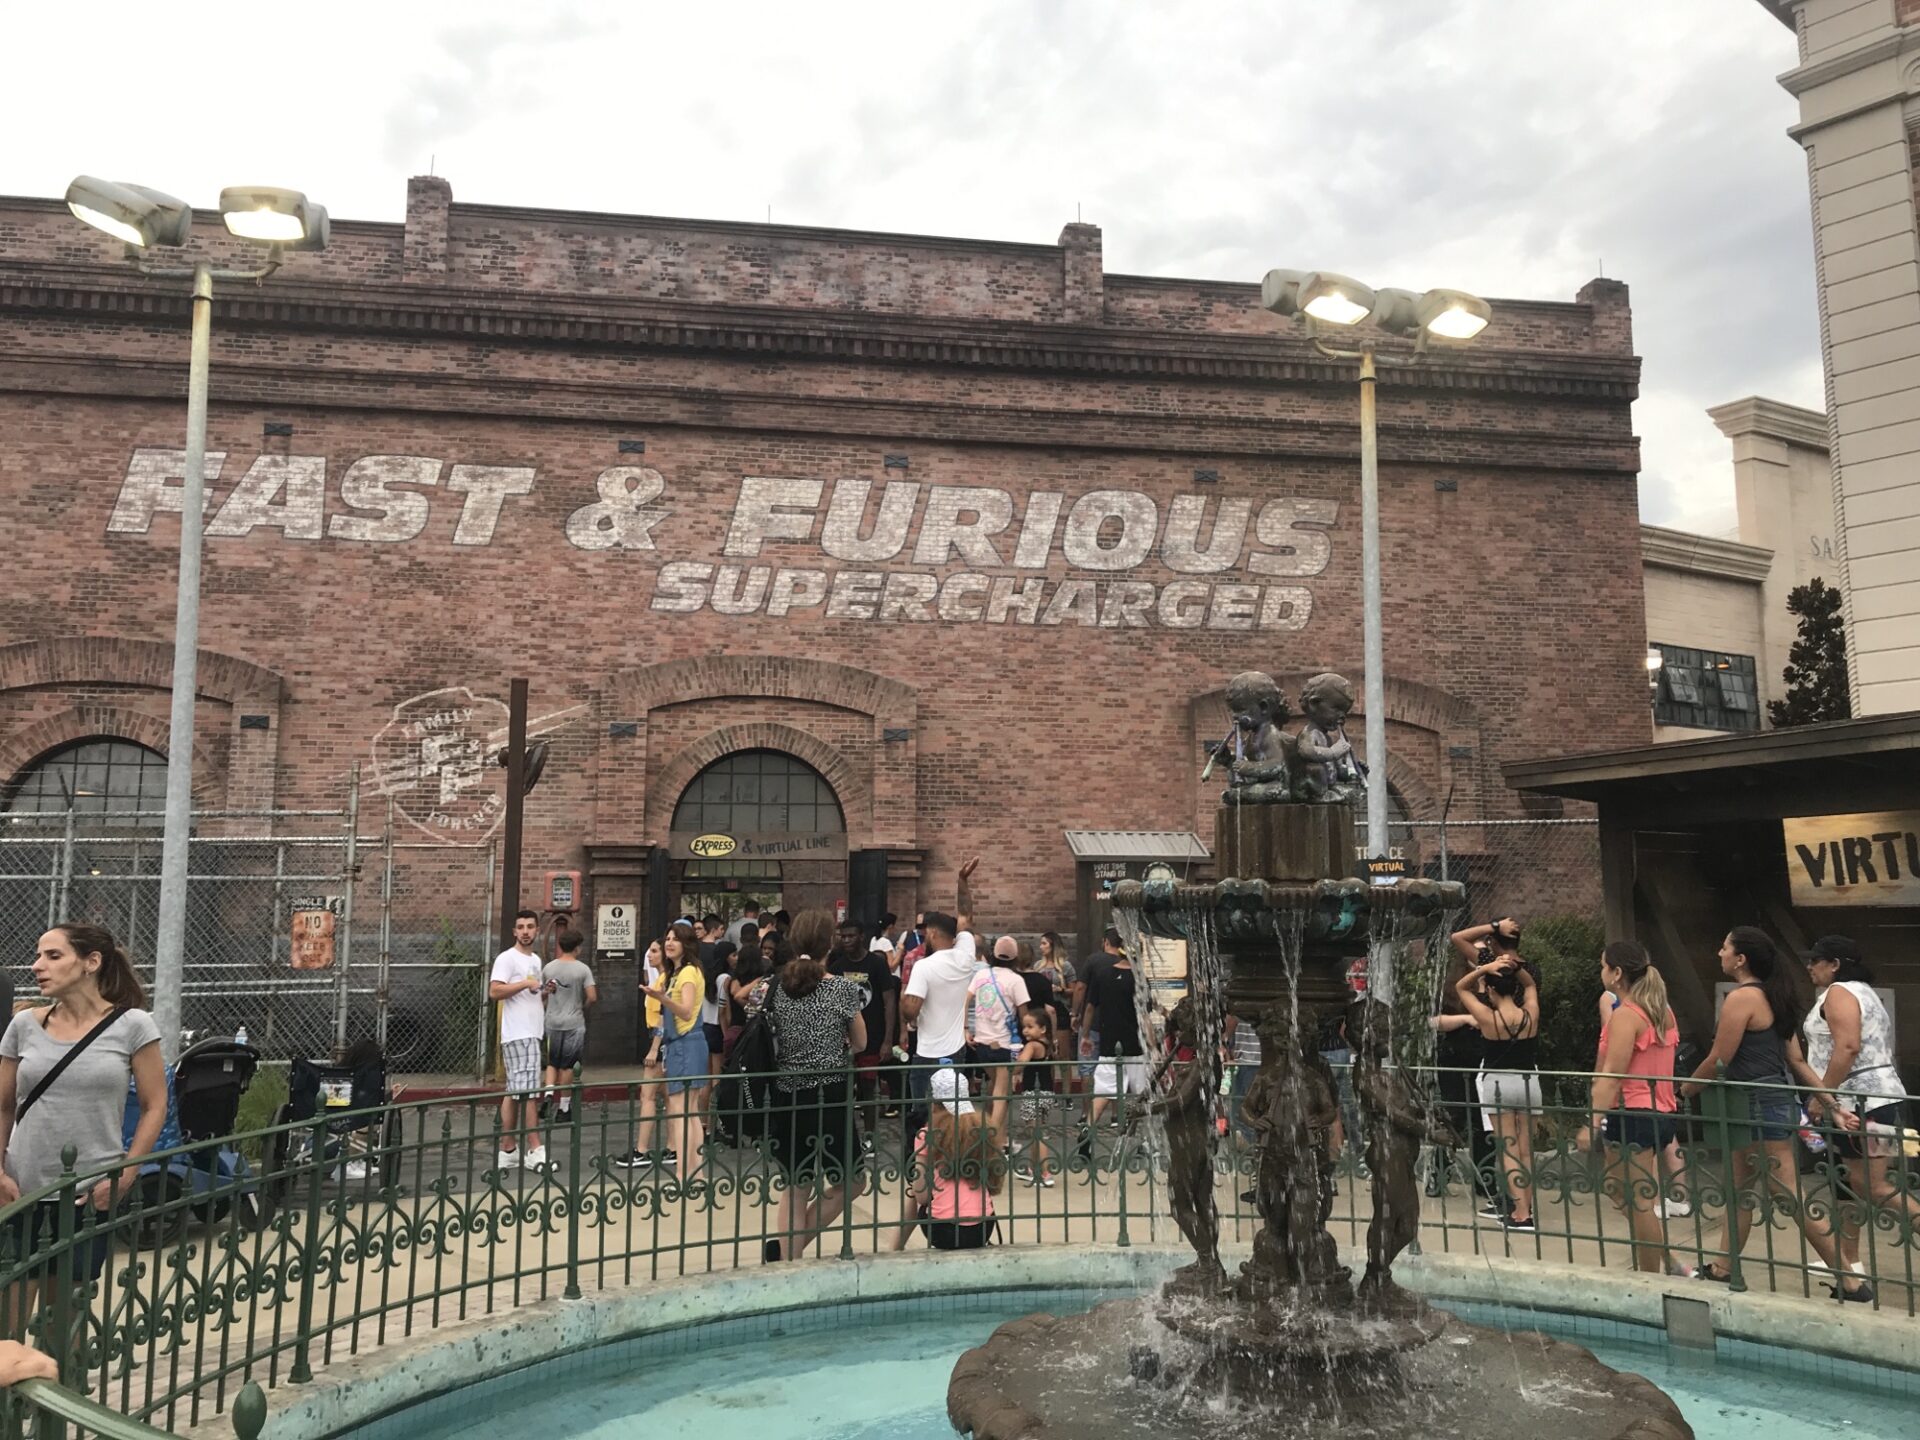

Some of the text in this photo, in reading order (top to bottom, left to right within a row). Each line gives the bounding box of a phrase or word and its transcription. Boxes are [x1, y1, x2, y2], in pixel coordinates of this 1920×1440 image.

[106, 448, 1340, 577] FAST & FURIOUS
[650, 561, 1313, 632] SUPERCHARGED
[402, 708, 473, 738] FAMILY
[427, 793, 501, 830] FOREVER
[693, 839, 734, 855] EXPRESS
[757, 839, 802, 855] VIRTUAL
[806, 836, 830, 849] LINE
[1795, 831, 1920, 888] VIRTU
[1095, 870, 1116, 878] STAND
[1368, 861, 1405, 872] VIRTUAL
[603, 928, 631, 936] RIDERS
